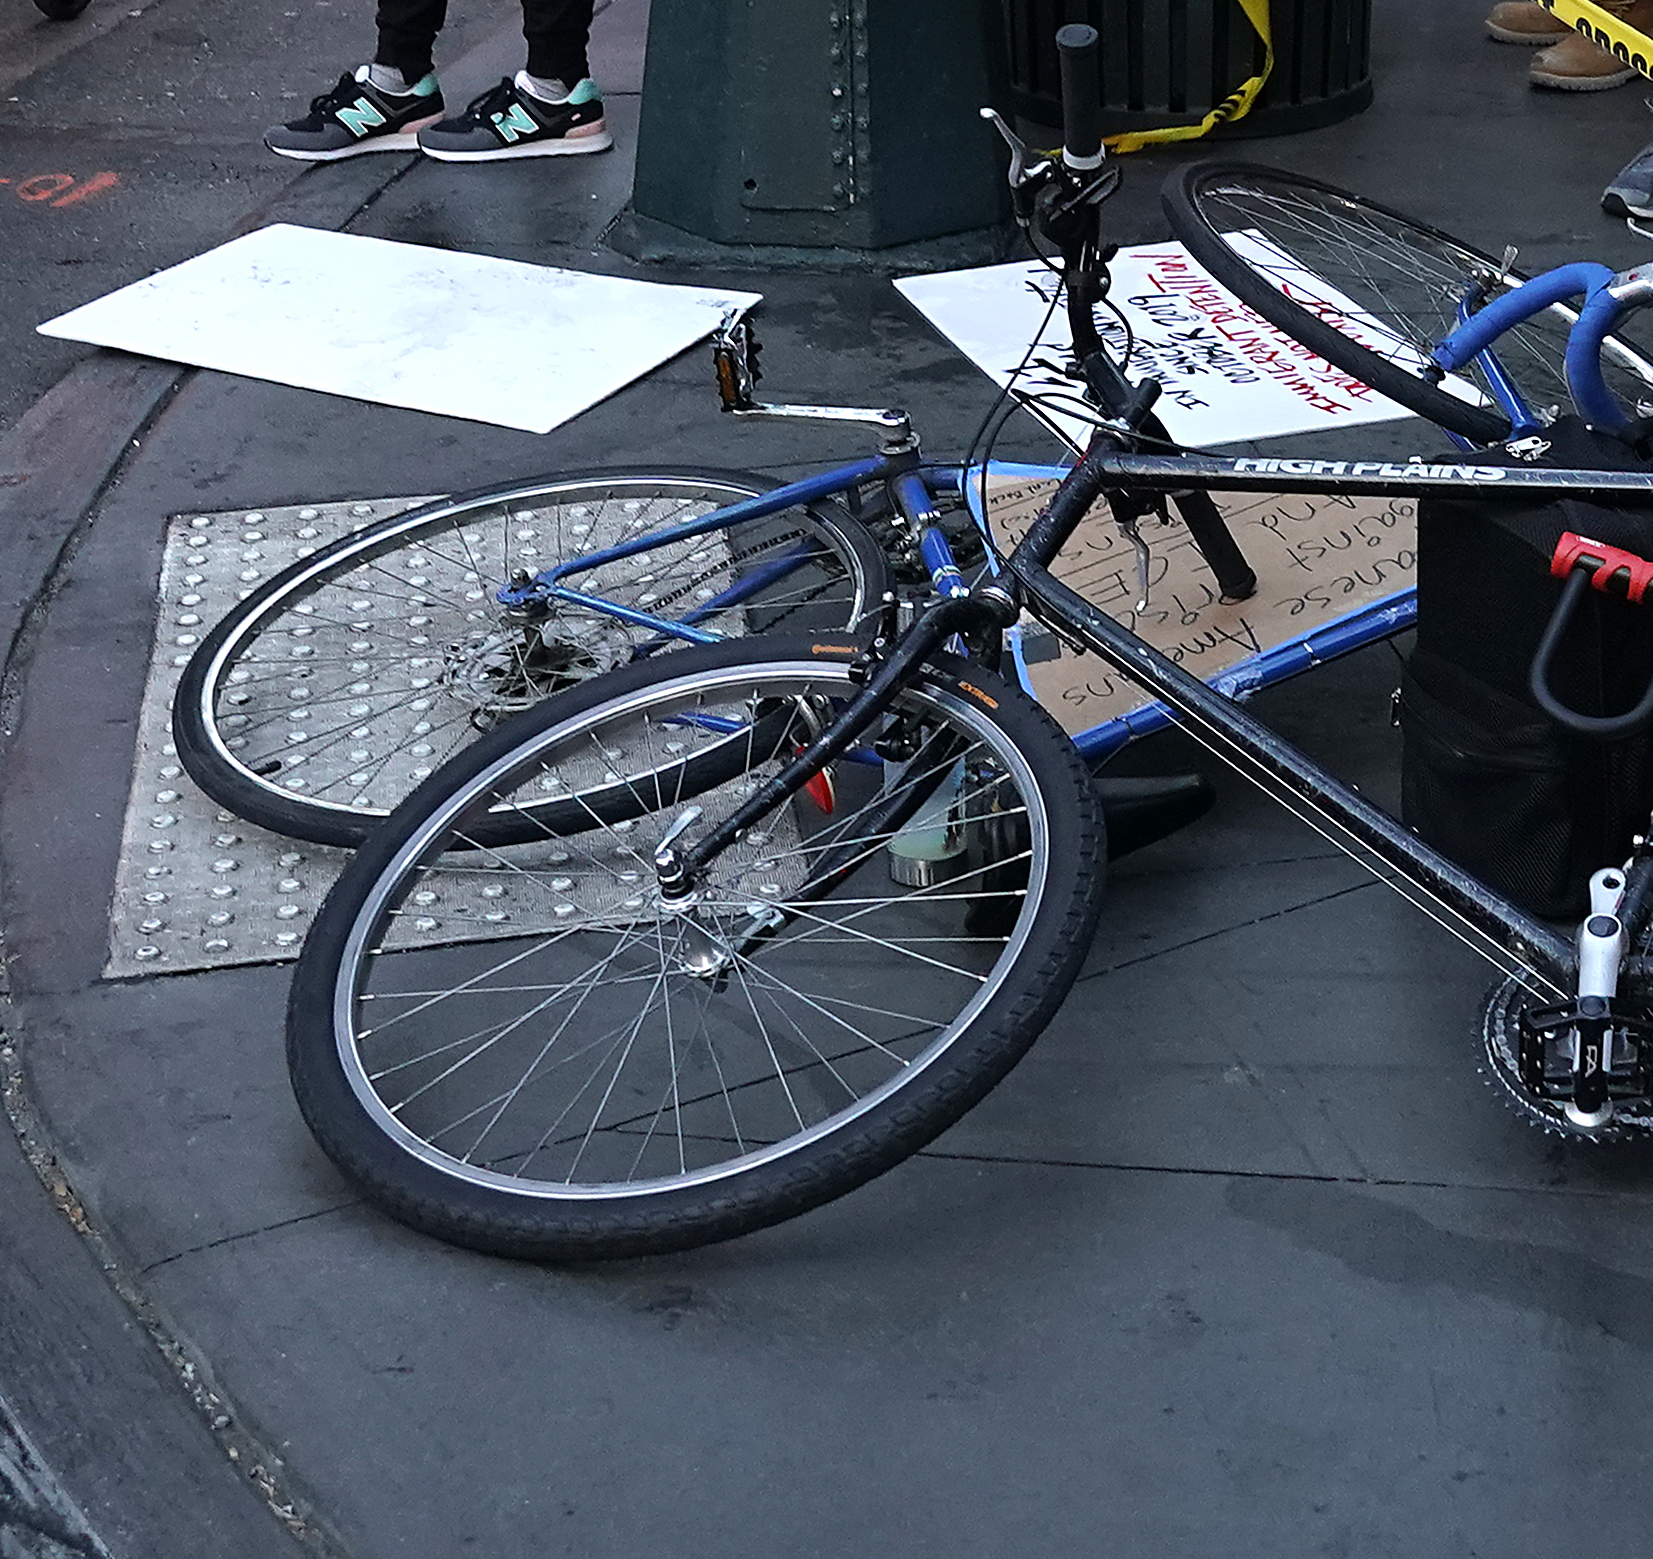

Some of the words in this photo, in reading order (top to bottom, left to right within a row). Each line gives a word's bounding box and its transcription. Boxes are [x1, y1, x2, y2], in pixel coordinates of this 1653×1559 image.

[1127, 293, 1191, 328] 2019
[1129, 254, 1241, 324] DETENTION
[1131, 336, 1211, 376] SINCE
[1167, 327, 1261, 384] OCTOBER
[1215, 325, 1353, 415] IMMIGRANT
[1233, 457, 1347, 476] HIGH
[1351, 461, 1506, 480] PLAINS
